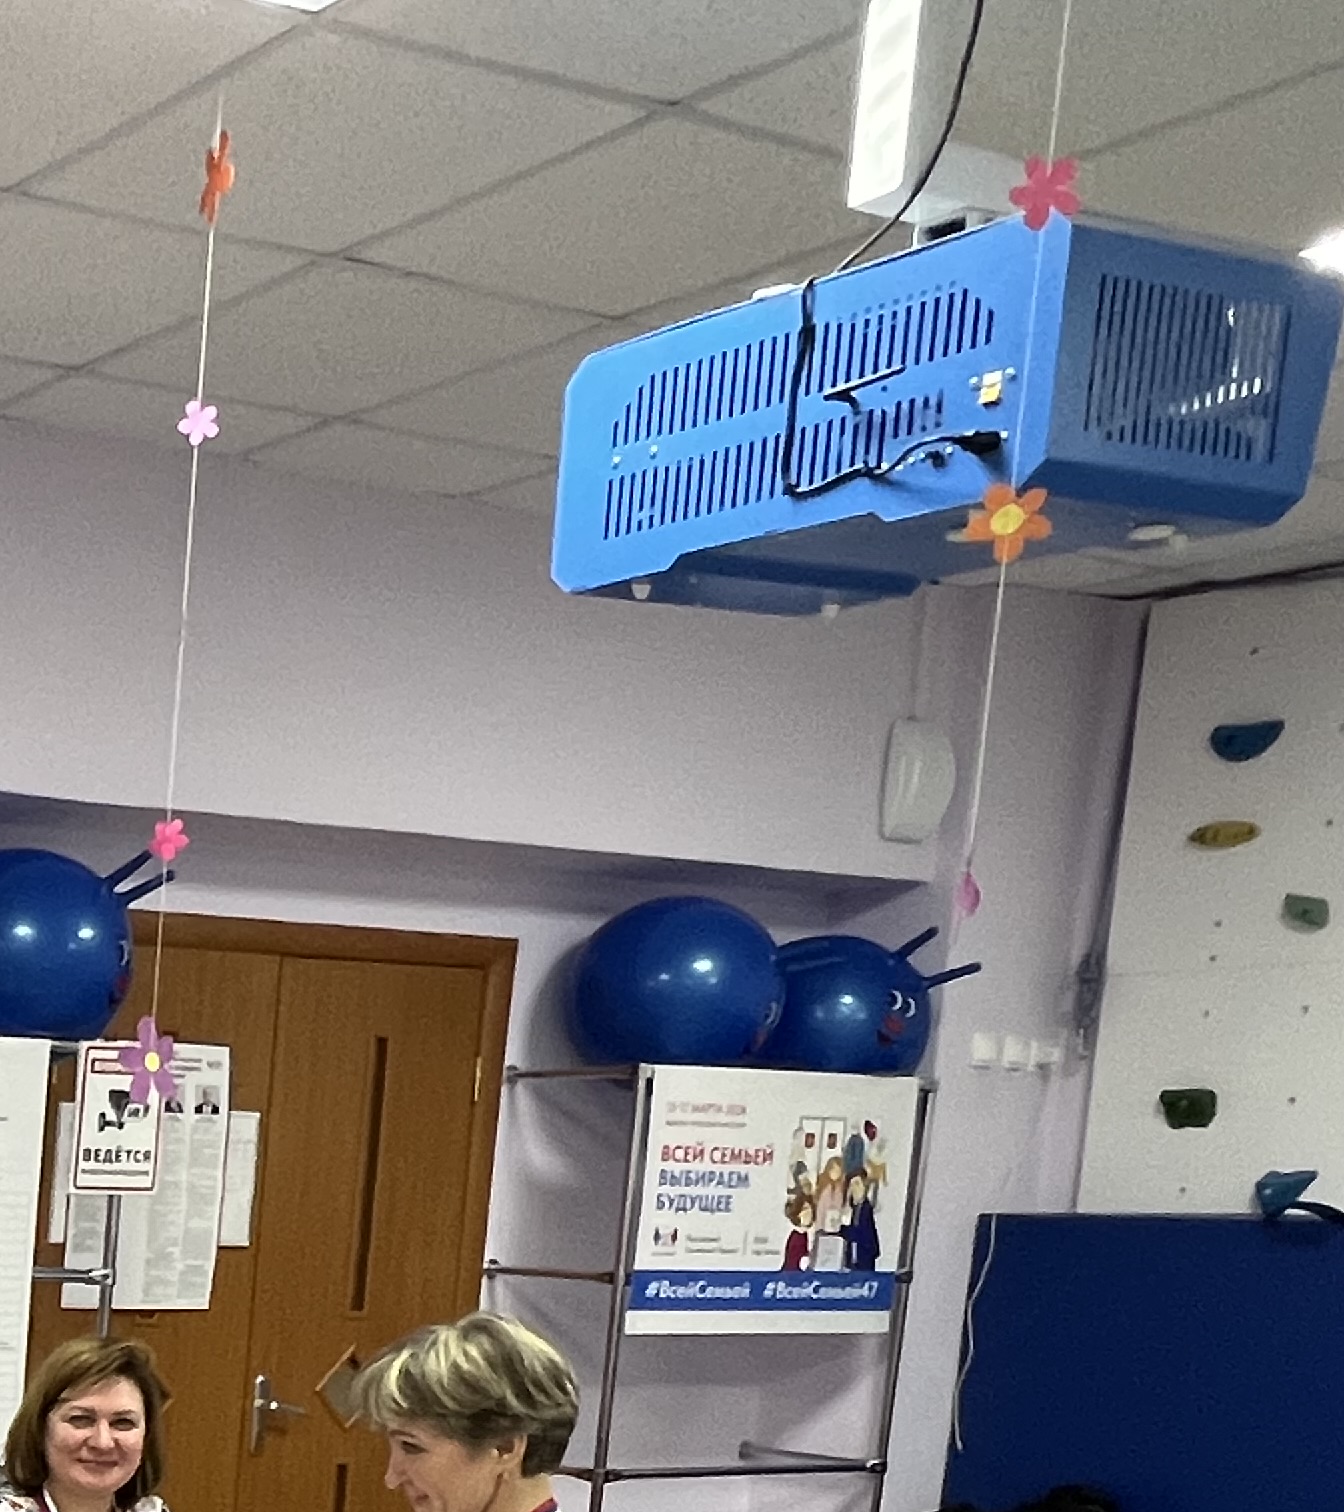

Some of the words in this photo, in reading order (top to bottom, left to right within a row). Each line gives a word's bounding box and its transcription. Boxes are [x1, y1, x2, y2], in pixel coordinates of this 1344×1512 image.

[661, 1141, 705, 1164] ВСЕЙ
[710, 1143, 774, 1166] СЕМЬЕЙ
[658, 1168, 750, 1189] ВЫБИРАЕМ
[656, 1193, 733, 1215] БУДУЩЕЕ
